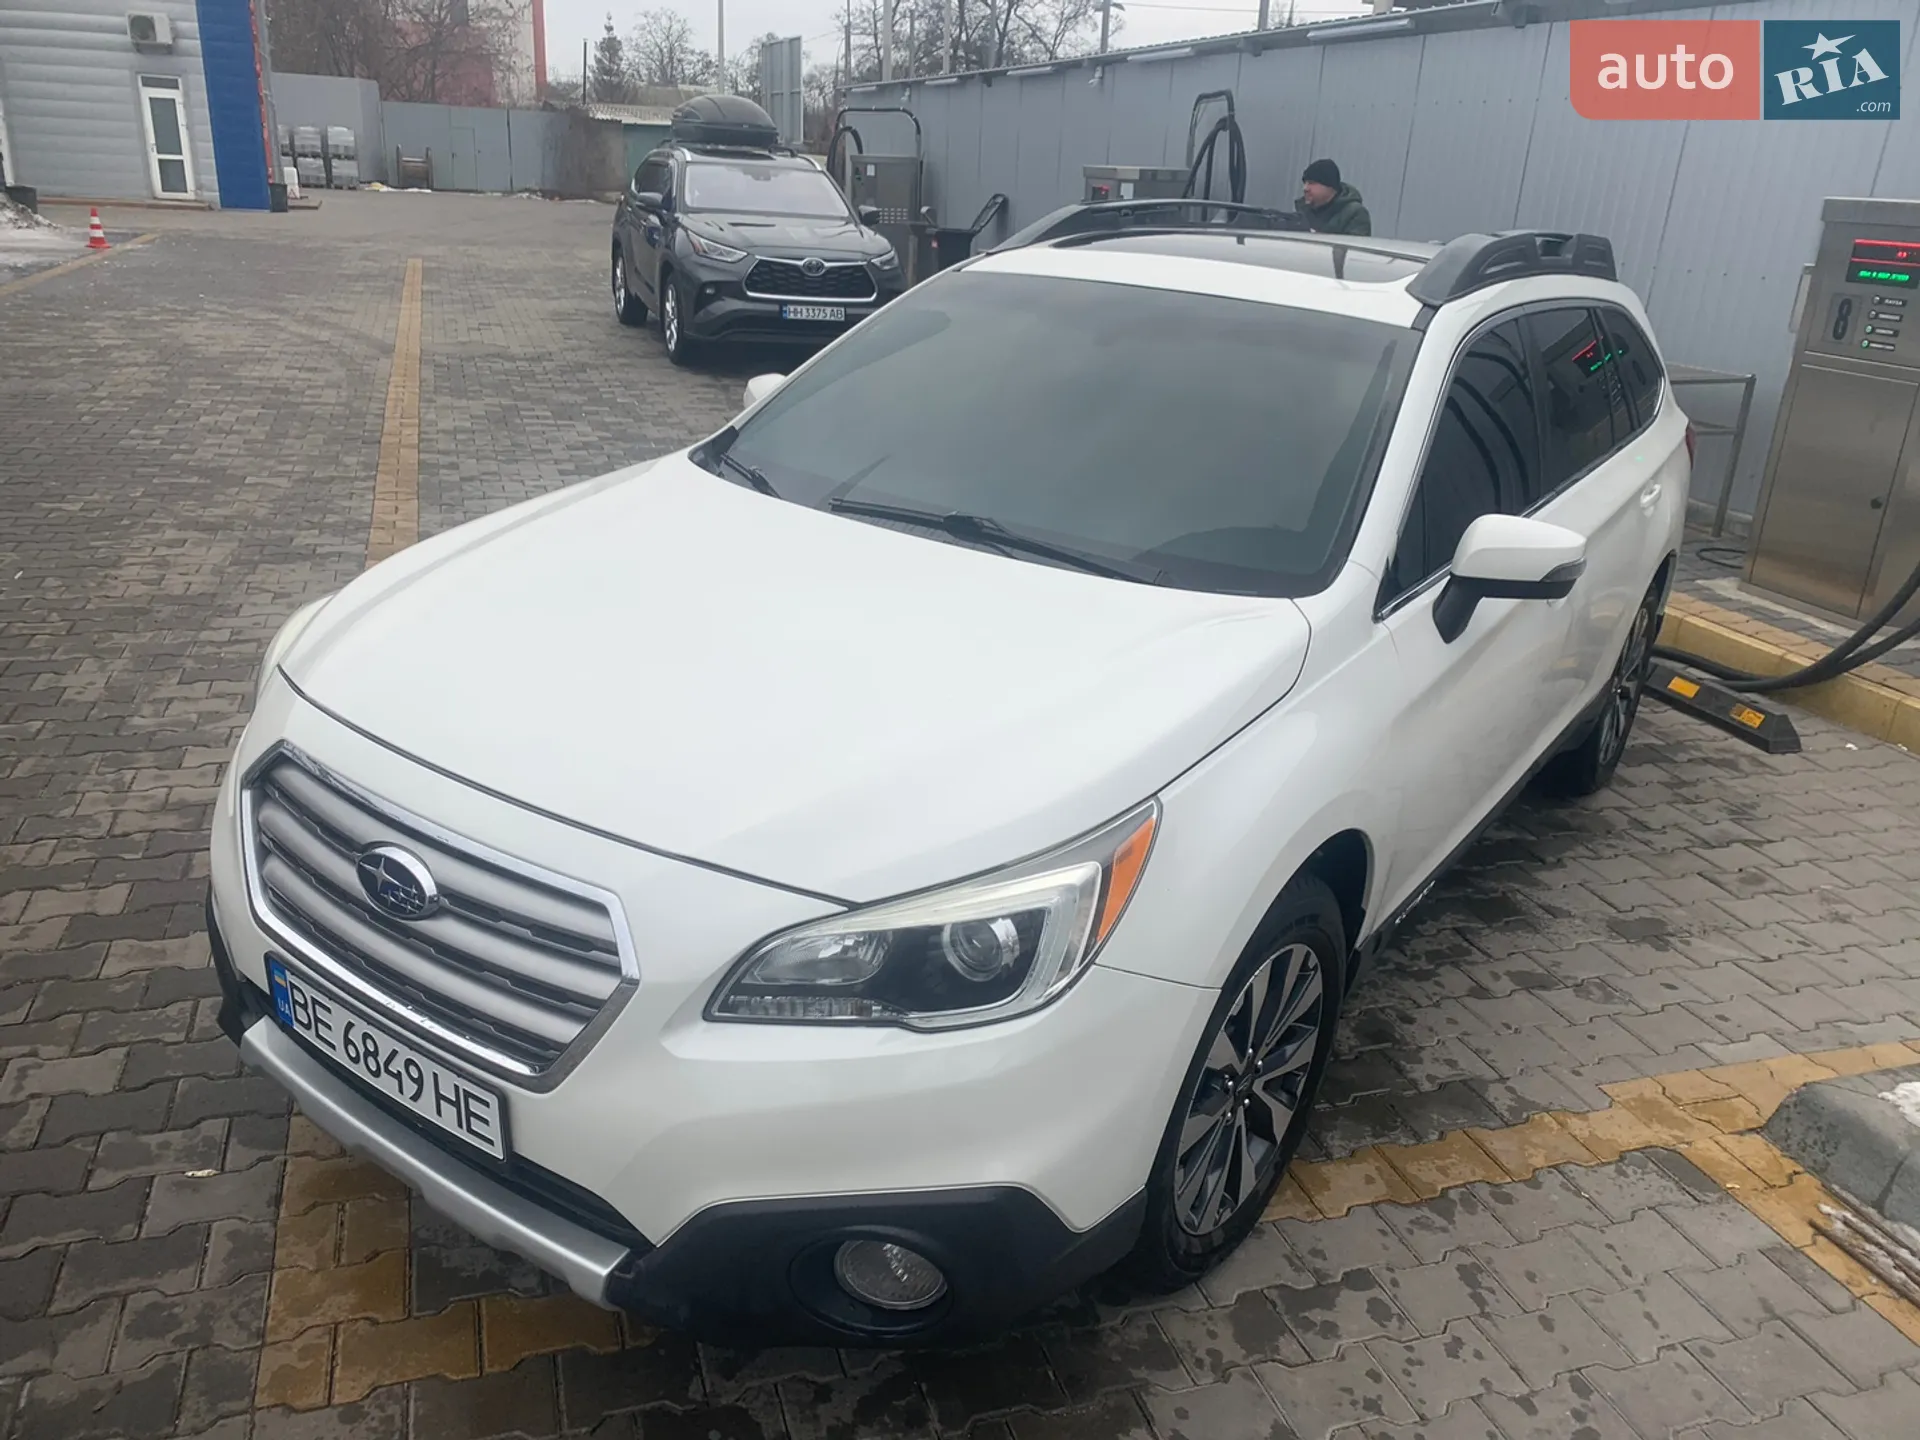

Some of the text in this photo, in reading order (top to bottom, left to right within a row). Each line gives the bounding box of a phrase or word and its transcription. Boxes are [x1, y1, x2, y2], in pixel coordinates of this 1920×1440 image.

[788, 306, 844, 320] HH 3375 AB
[277, 997, 292, 1018] UA
[289, 980, 495, 1147] BE 6849 HE
